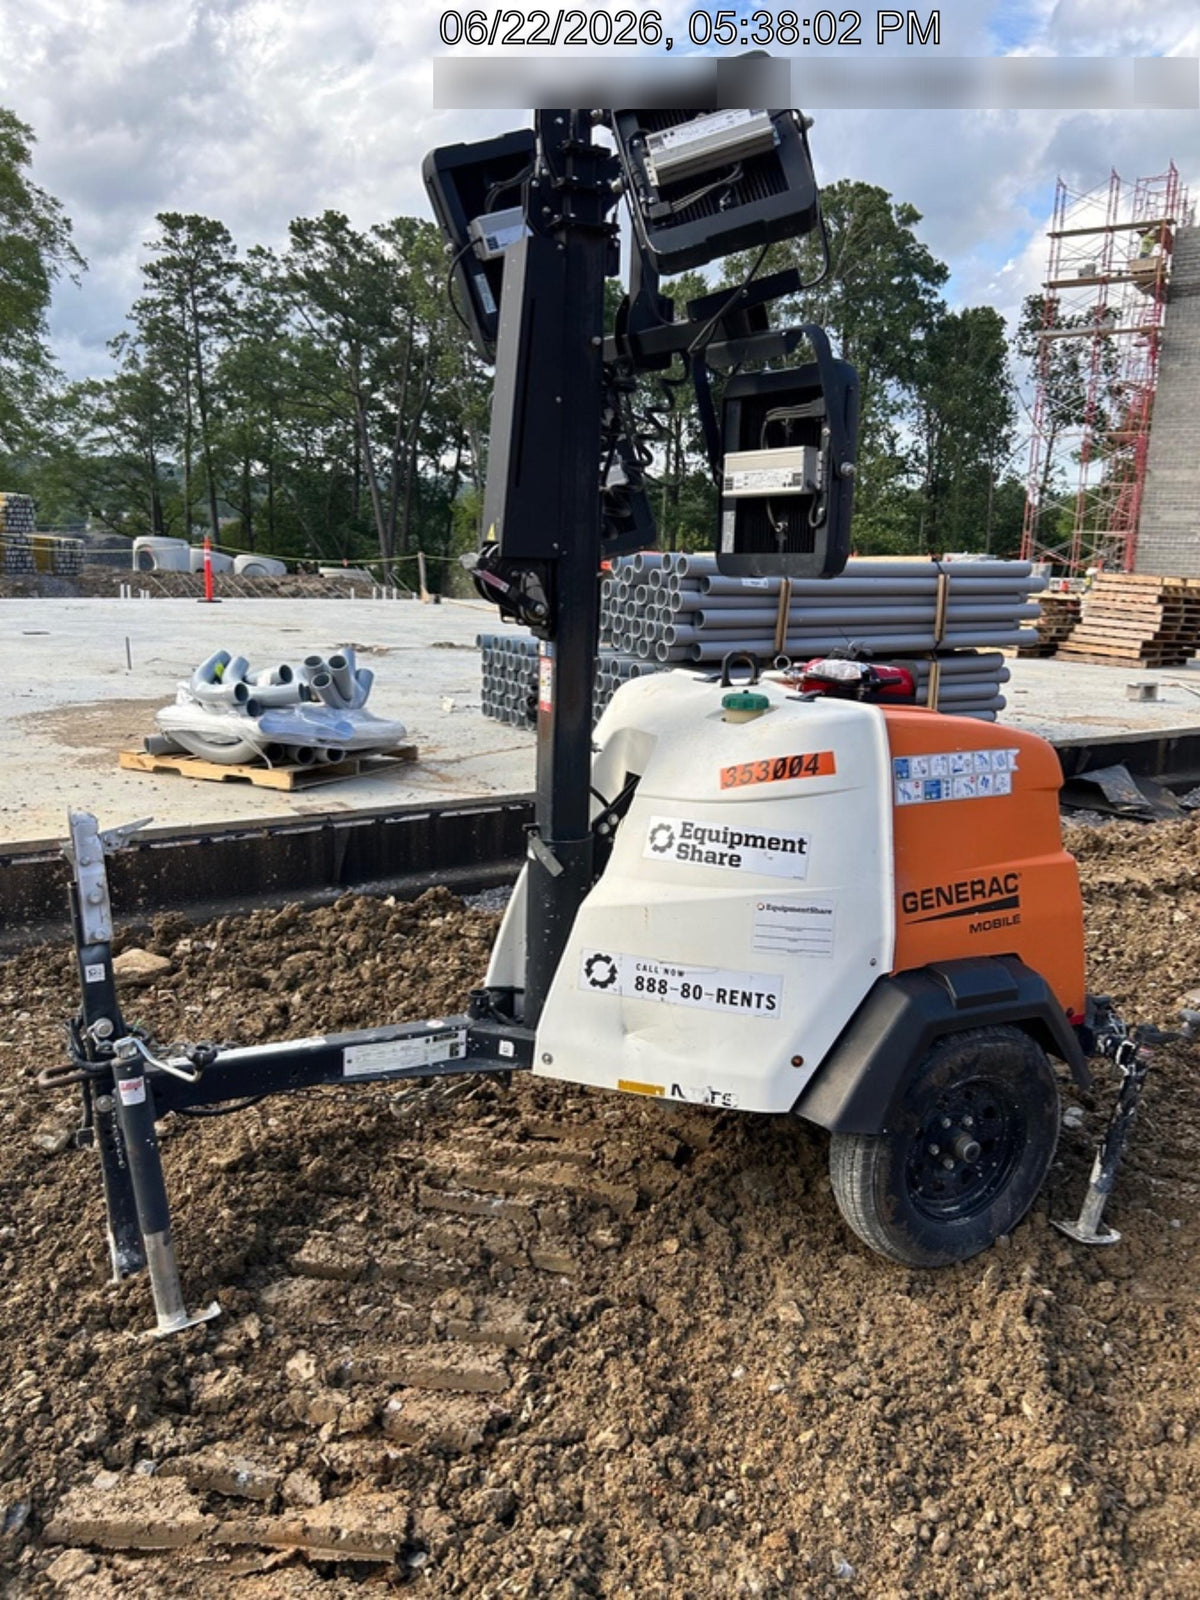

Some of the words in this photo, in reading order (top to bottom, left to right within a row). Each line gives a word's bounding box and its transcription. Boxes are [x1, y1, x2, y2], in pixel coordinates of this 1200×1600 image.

[725, 752, 819, 788] 353004
[679, 821, 807, 855] Equipment
[676, 842, 742, 868] Share
[902, 872, 1020, 914] GENERAC
[766, 903, 832, 915] EquipmentShare
[969, 913, 1021, 934] MOBILE
[636, 963, 659, 975] CALL
[663, 968, 685, 977] NOW
[634, 975, 776, 1011] 888-80-RENTS
